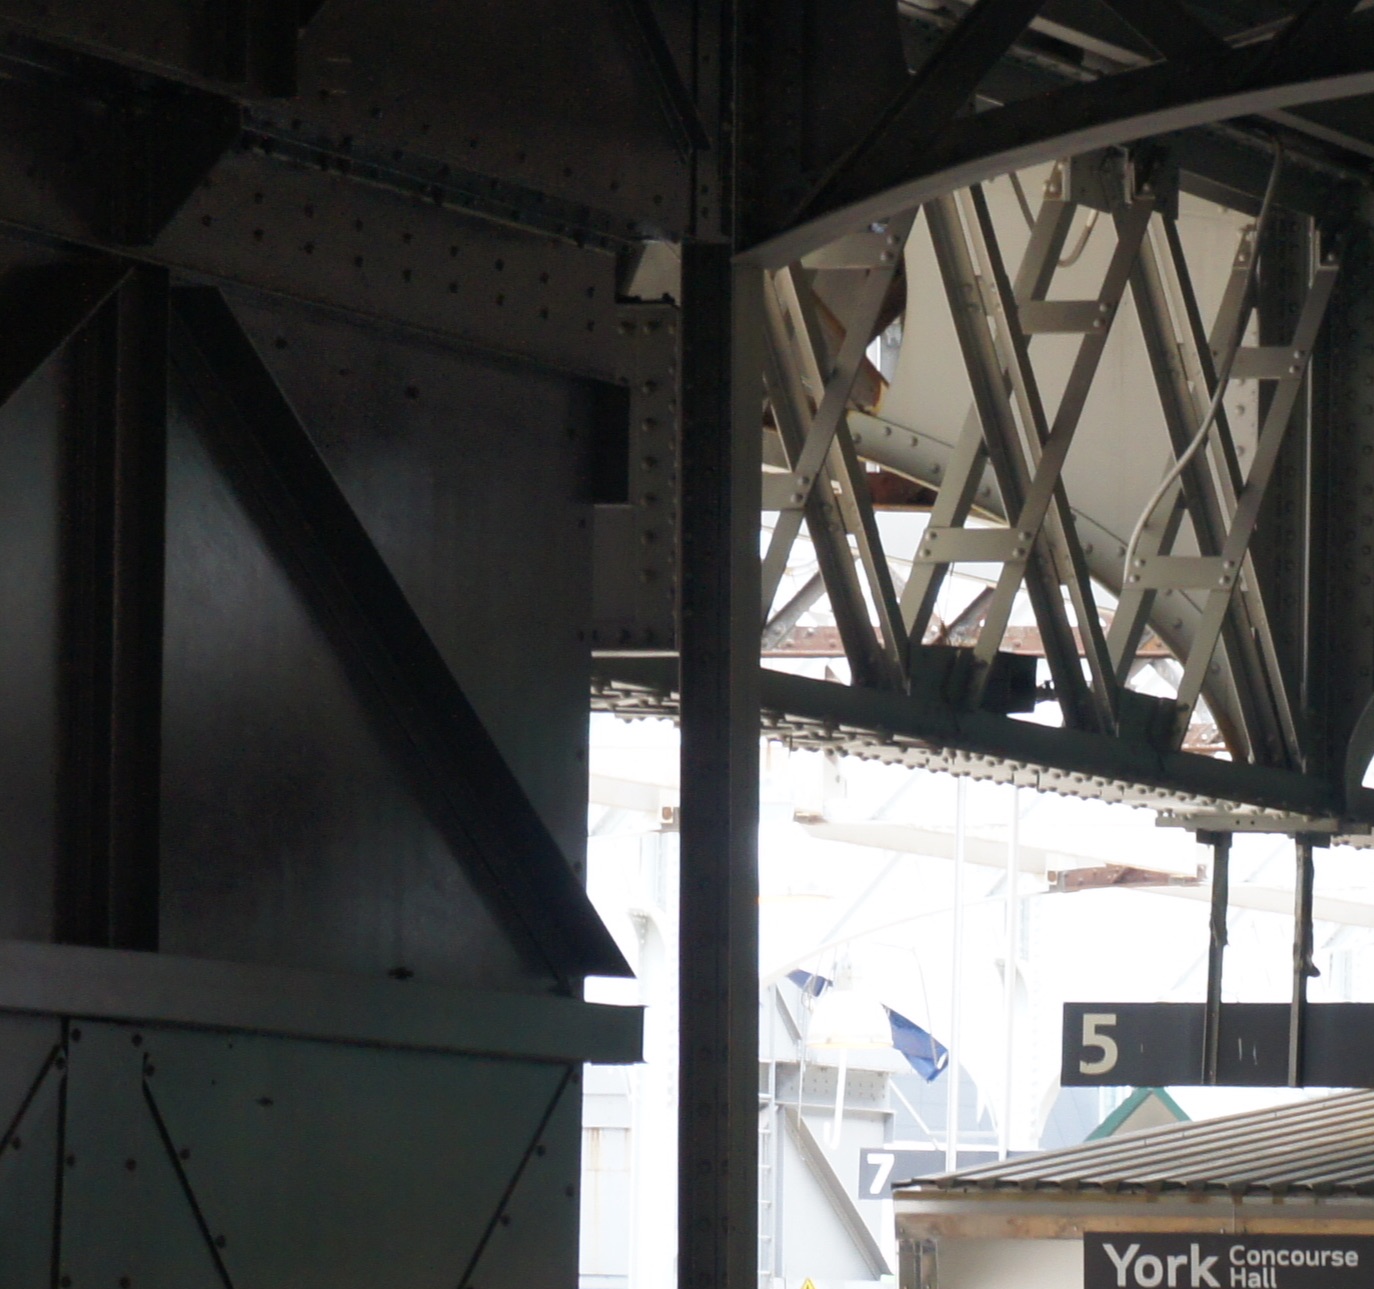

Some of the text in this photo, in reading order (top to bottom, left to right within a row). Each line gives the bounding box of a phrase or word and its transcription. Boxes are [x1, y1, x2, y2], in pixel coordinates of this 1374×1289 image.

[1079, 1013, 1119, 1075] 5
[867, 1153, 895, 1195] 7
[1102, 1243, 1359, 1288] York Concourse
[1230, 1267, 1277, 1289] Hall
